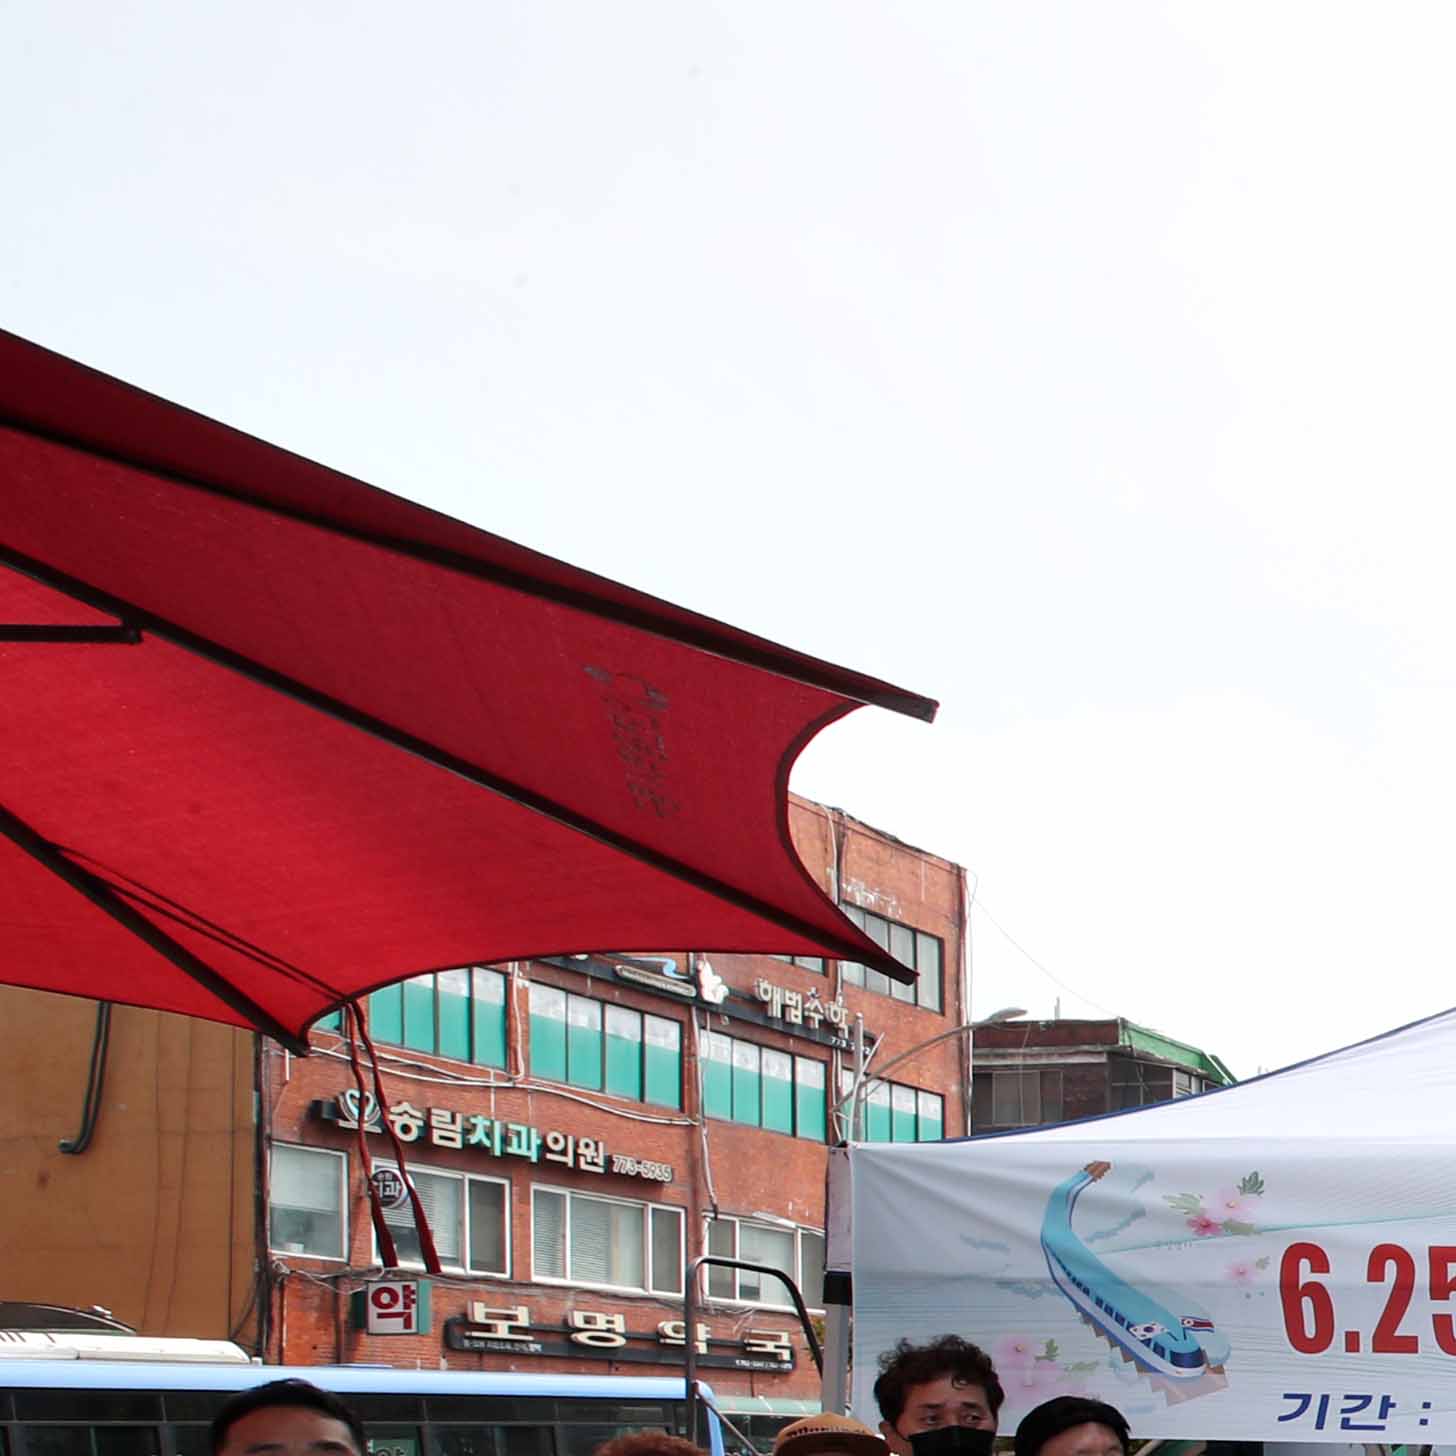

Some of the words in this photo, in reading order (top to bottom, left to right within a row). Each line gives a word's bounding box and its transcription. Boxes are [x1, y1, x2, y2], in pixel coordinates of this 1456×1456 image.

[388, 1102, 605, 1174] 송림치과의원
[370, 1284, 417, 1331] 약
[464, 1300, 793, 1362] 보명약국
[1277, 1392, 1396, 1432] 기간
